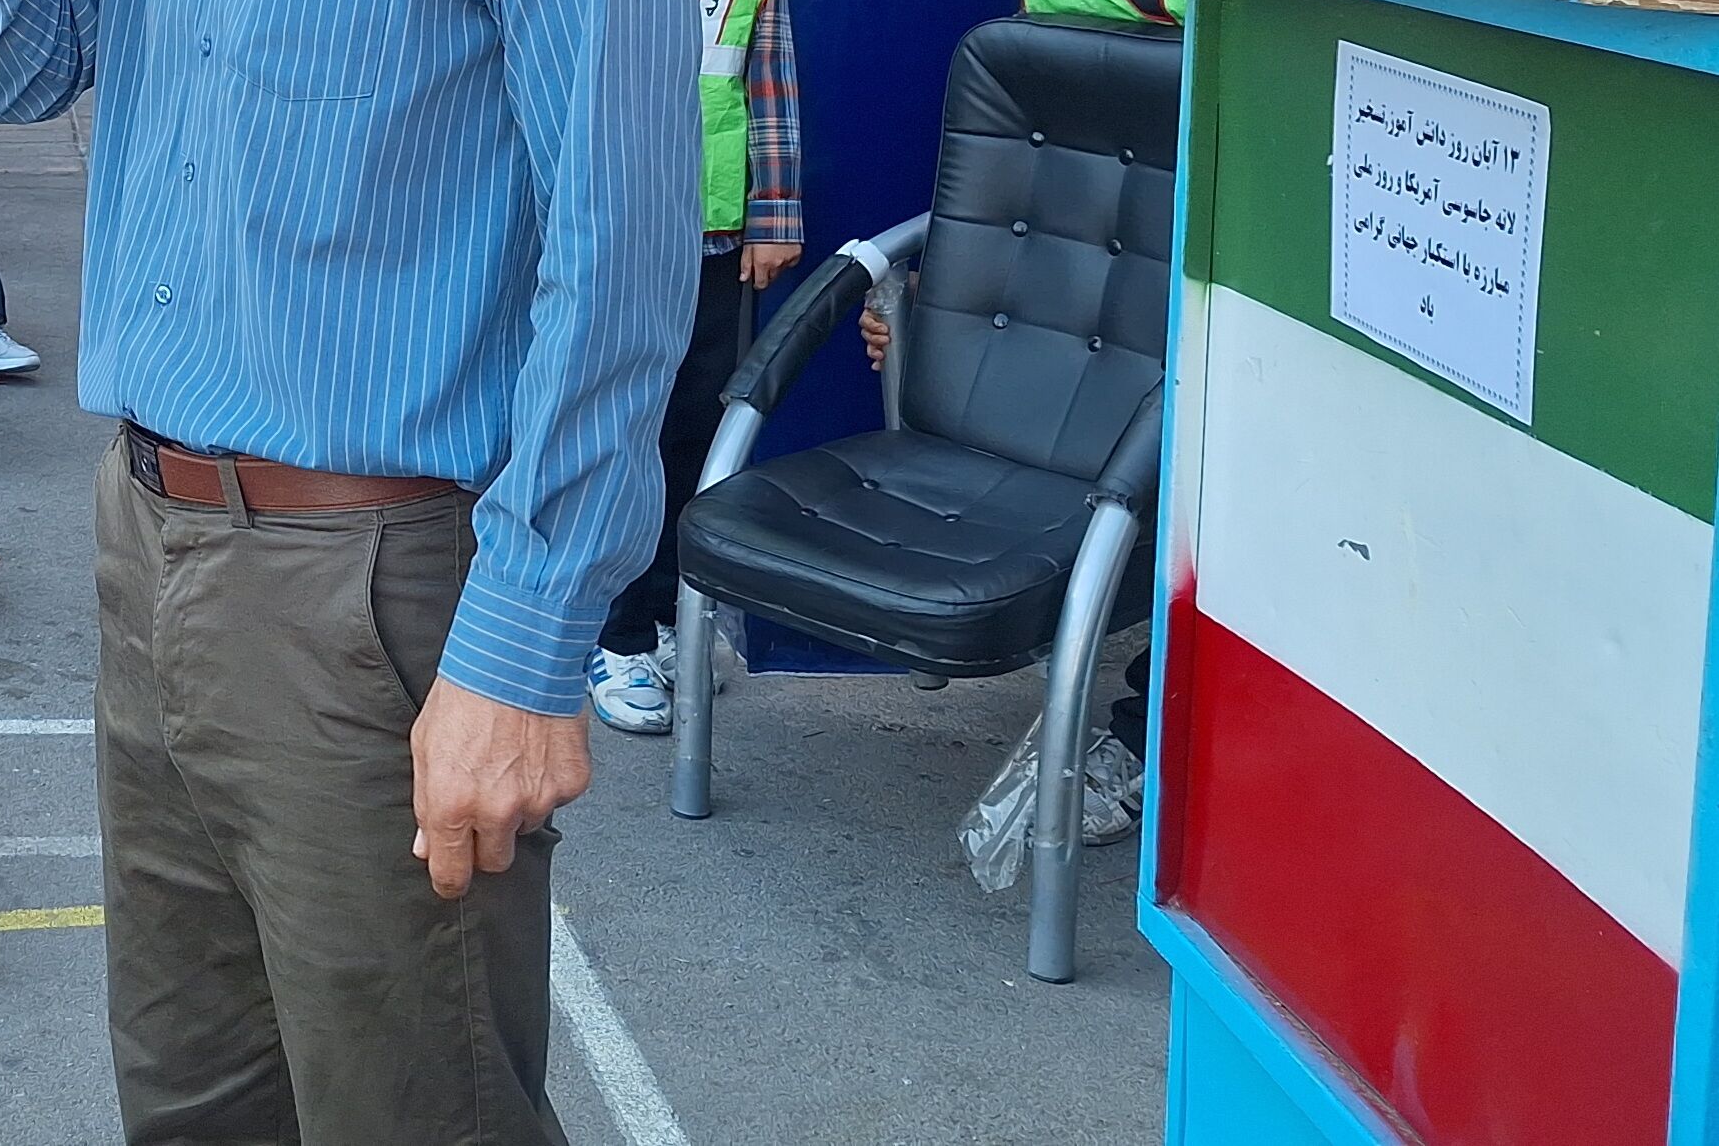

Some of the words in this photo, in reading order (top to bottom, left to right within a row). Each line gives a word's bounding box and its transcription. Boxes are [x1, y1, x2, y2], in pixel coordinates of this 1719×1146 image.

[1415, 119, 1446, 146] دانش
[1447, 132, 1470, 163] روز
[1353, 153, 1373, 179] ملی
[1471, 139, 1501, 171] آبان
[1503, 144, 1521, 174] ۱۳
[1375, 162, 1394, 192] روز
[1404, 168, 1440, 206] آمریکا
[1354, 211, 1386, 241] گرامی
[1441, 198, 1492, 232] جاسوسی
[1495, 207, 1517, 235] لانه
[1387, 222, 1419, 258] جهانی
[1421, 237, 1460, 272] استکبار
[1462, 252, 1471, 284] با
[1474, 265, 1510, 298] مبارزه
[1419, 294, 1435, 325] باد
